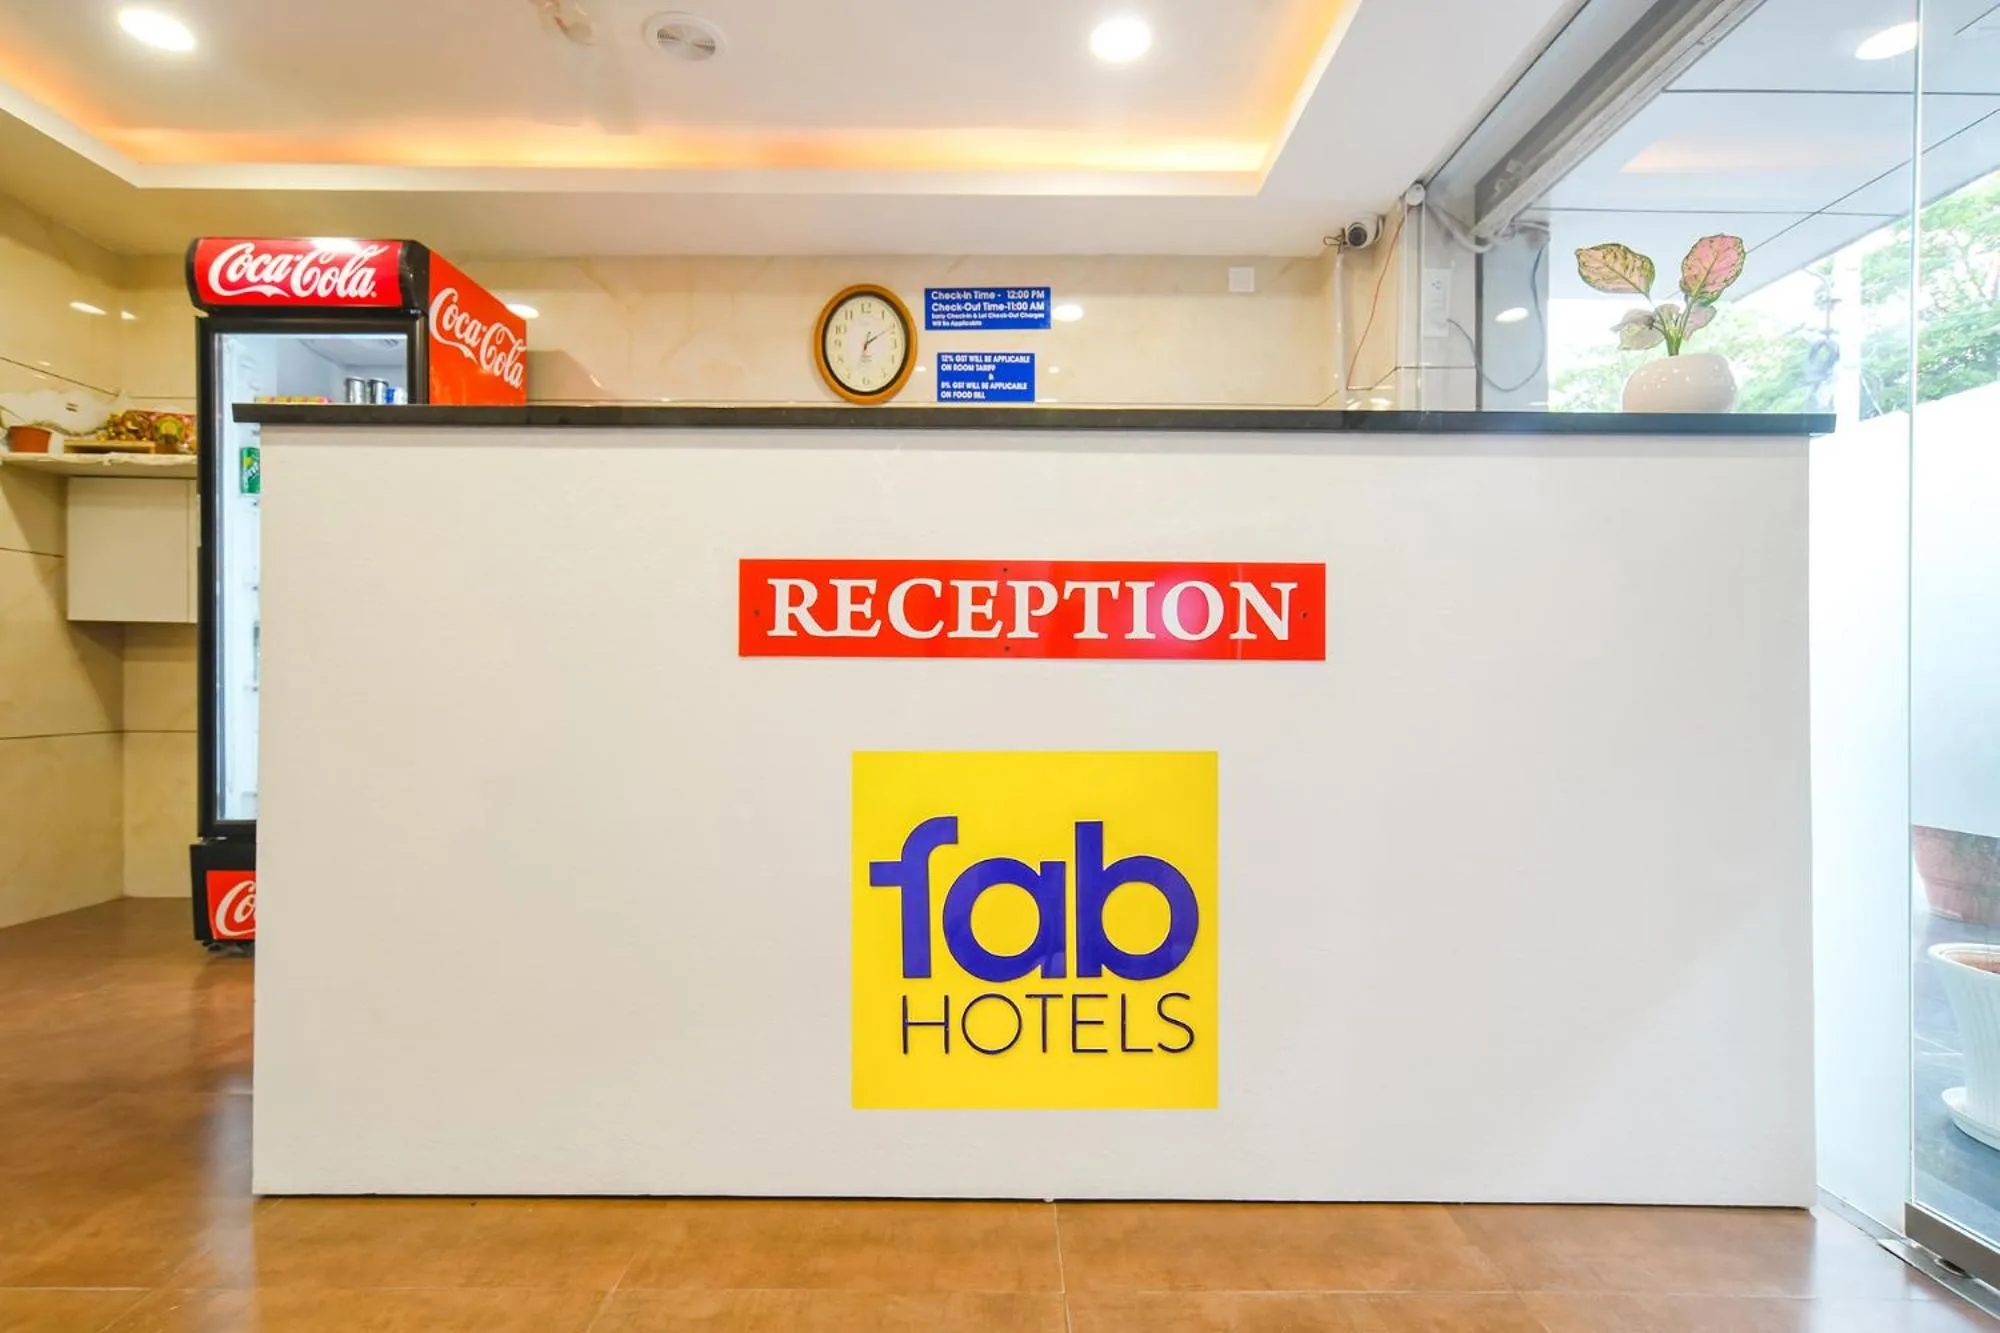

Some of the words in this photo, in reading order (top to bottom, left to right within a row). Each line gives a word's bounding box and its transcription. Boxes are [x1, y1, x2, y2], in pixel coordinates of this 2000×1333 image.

[208, 243, 390, 299] Coca-Cola
[931, 291, 972, 300] Check-In
[973, 291, 995, 300] Time
[1007, 290, 1029, 300] 12:00
[1031, 290, 1044, 299] PM
[931, 302, 981, 312] Check-Out
[1029, 301, 1044, 311] AM
[429, 287, 526, 389] Coca-Cola
[973, 391, 985, 399] BILL
[981, 382, 989, 390] BE
[990, 382, 1028, 390] APPLICABLE
[766, 577, 1298, 641] RECEPTION
[869, 815, 1199, 982] fab
[902, 992, 1195, 1055] HOTELS
